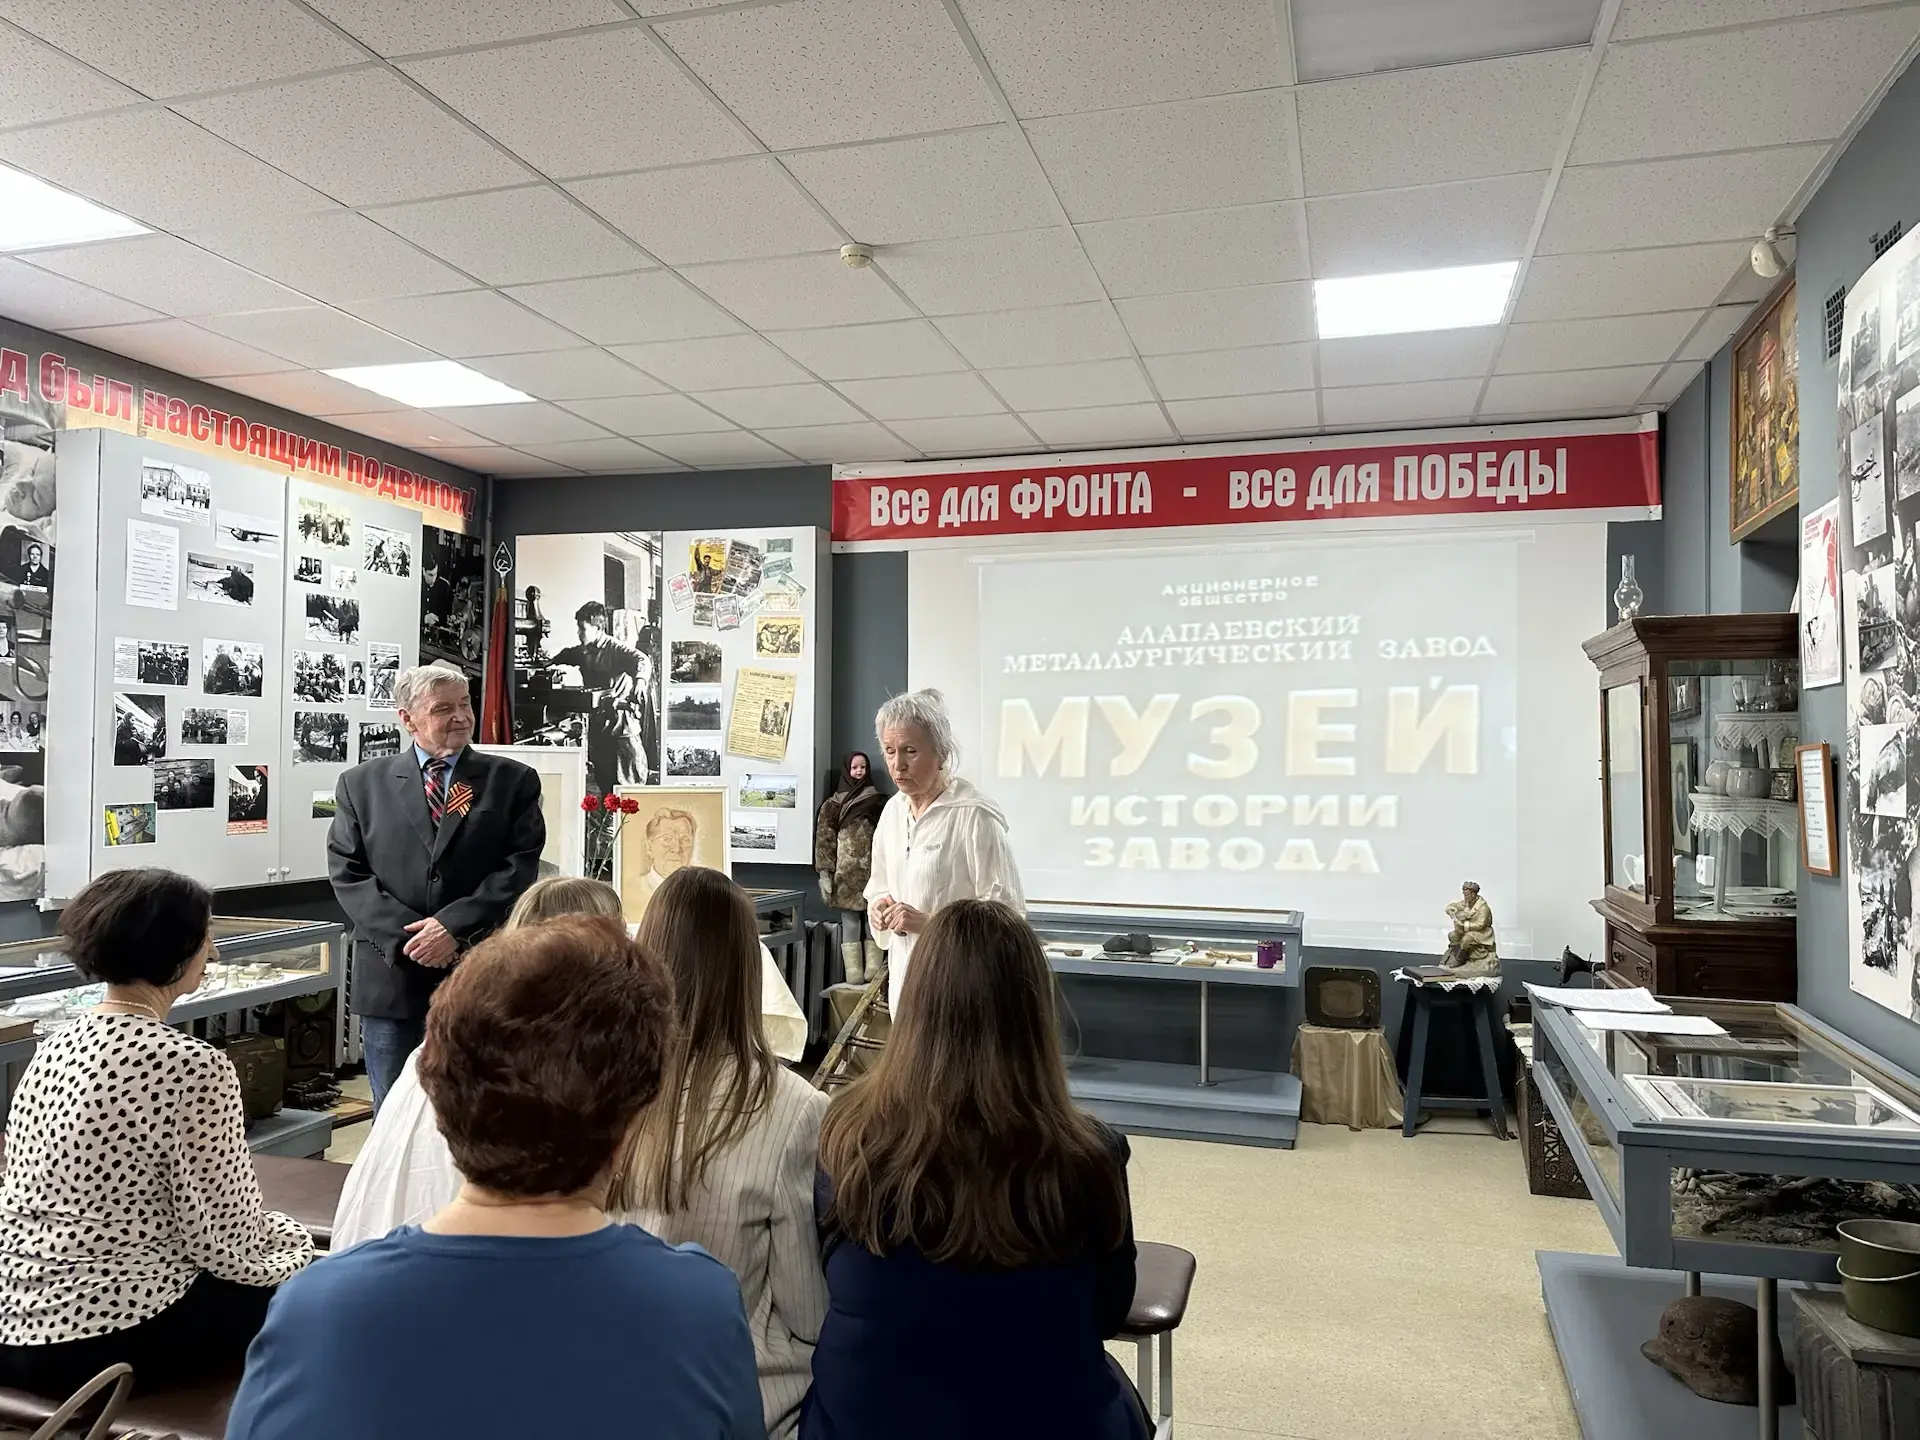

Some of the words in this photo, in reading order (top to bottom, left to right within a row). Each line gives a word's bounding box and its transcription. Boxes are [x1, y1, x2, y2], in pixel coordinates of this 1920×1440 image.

[39, 351, 134, 424] был
[143, 388, 341, 480] настоящим
[347, 450, 478, 521] подвигом!
[870, 485, 930, 526] Все
[937, 484, 999, 528] для
[1009, 471, 1152, 519] ФРОНТА
[1183, 487, 1197, 497] -
[1229, 467, 1296, 509] все
[1306, 463, 1380, 510] для
[1393, 448, 1567, 504] ПОБЕДЫ
[1161, 575, 1320, 596] АКЦИОНЕРНОЕ
[1116, 612, 1361, 645] АЛАПАЕВСКИЙ
[1002, 638, 1353, 673] МЕТАЛЛУРГИЧЕСКИЙ
[1378, 635, 1497, 659] ЗАВОД
[997, 676, 1481, 779] МУЗЕЙ
[1069, 793, 1399, 828] ИСТОРИИ
[1083, 837, 1381, 873] ЗАВОДА
